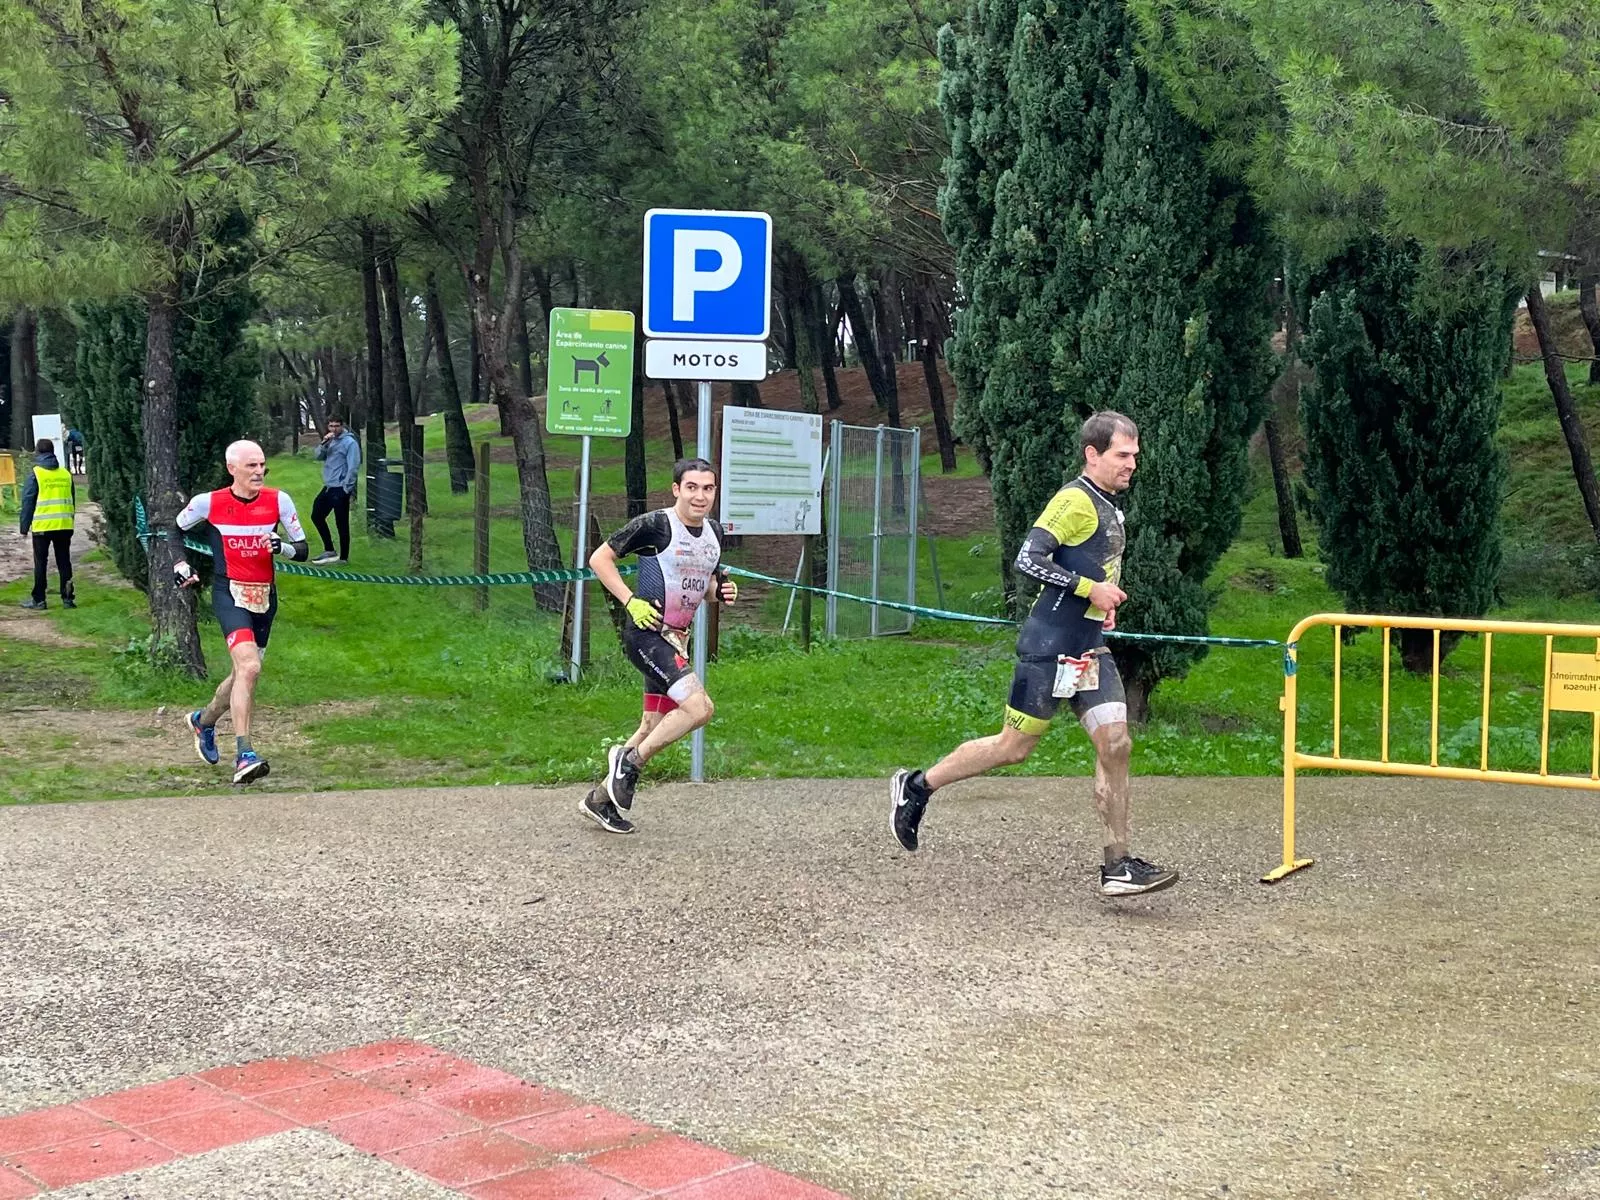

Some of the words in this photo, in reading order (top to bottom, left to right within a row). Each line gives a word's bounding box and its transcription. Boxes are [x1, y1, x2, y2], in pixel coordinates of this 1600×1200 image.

[673, 229, 742, 322] P
[573, 331, 582, 340] de
[673, 354, 739, 367] MOTOS
